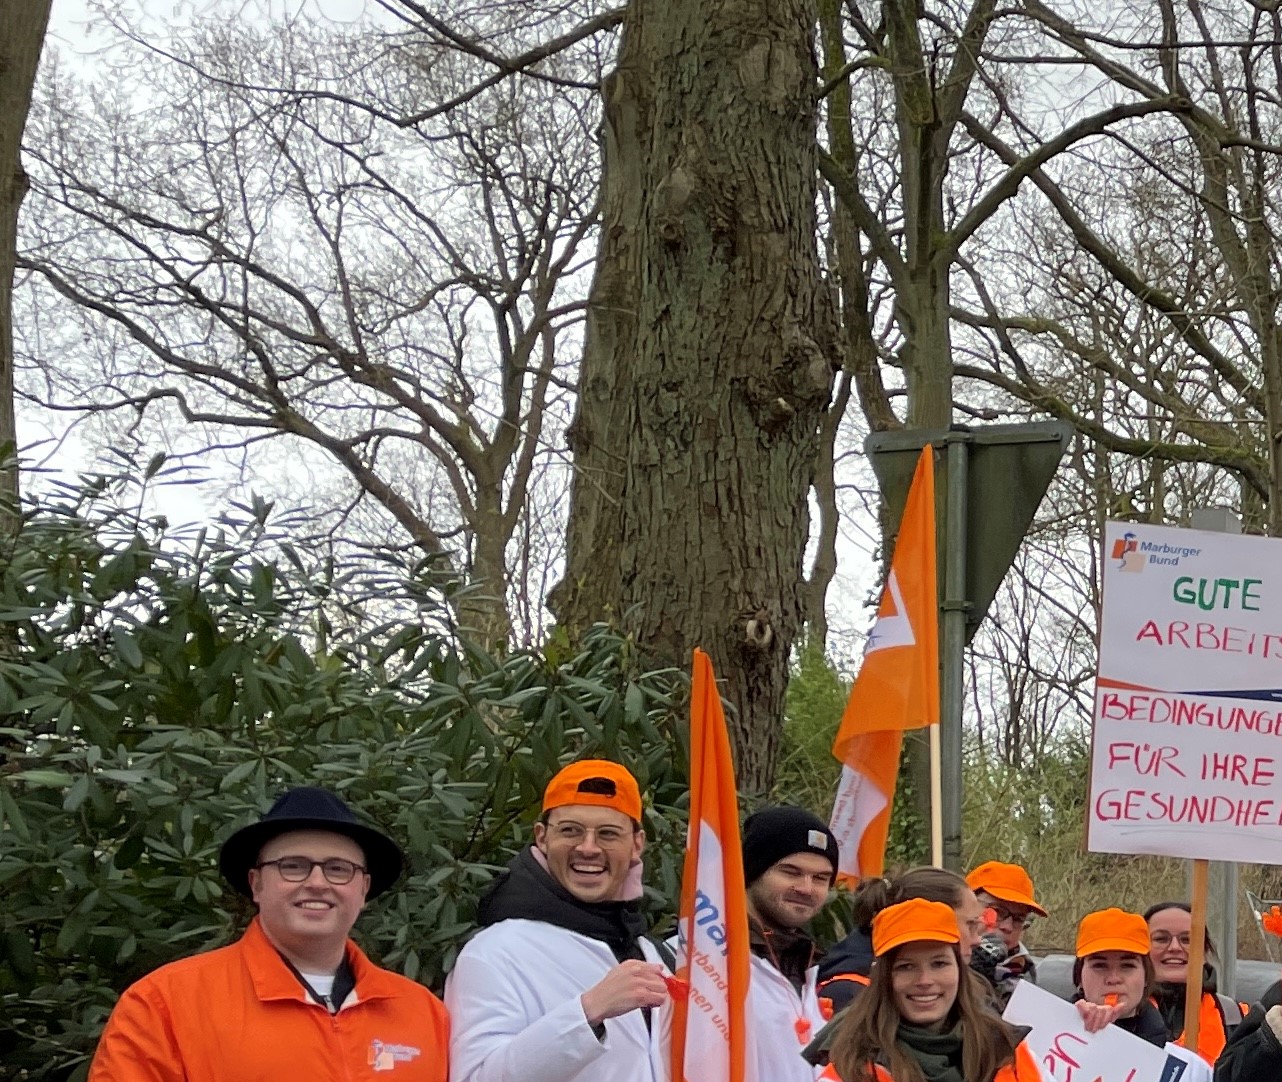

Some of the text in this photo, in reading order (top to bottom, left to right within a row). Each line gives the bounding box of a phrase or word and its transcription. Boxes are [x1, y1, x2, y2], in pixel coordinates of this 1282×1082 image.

[1140, 541, 1202, 557] Marburger
[1149, 554, 1179, 567] Bund
[1173, 576, 1263, 611] GUTE
[1109, 743, 1275, 786] FÜR IHRE
